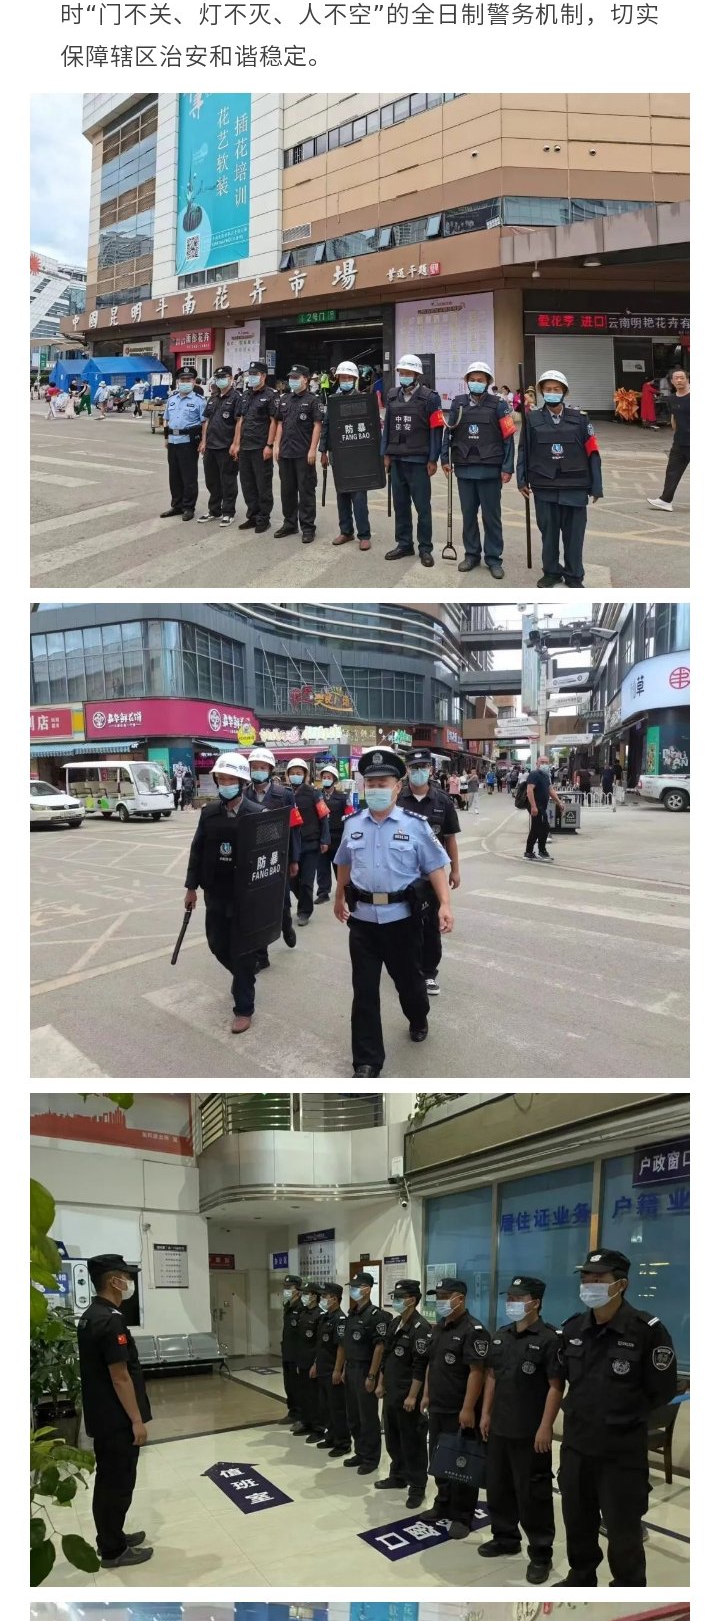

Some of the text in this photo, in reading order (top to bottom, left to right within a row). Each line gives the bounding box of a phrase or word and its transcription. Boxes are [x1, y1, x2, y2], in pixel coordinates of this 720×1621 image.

[215, 105, 230, 197] 花艺软装
[233, 112, 249, 207] 插花培训
[345, 423, 367, 434] 防暴
[257, 851, 278, 869] 防暴
